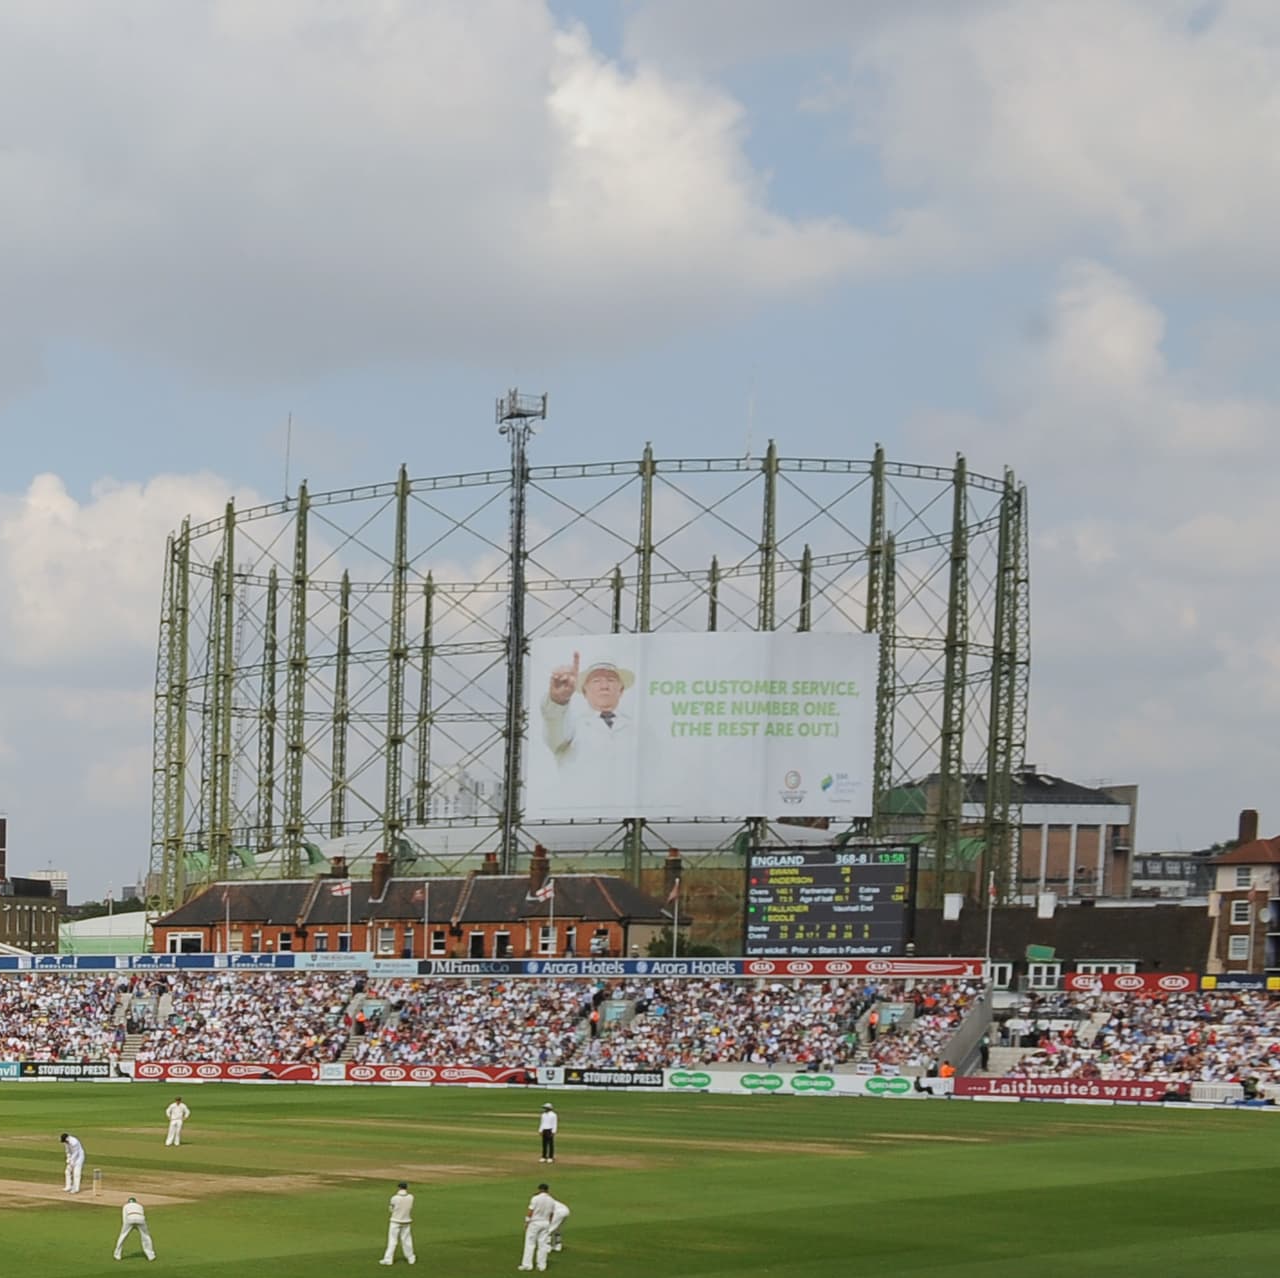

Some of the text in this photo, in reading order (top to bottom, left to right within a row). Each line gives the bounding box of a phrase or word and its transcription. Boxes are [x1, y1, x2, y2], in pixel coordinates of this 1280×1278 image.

[649, 680, 860, 698] FOR CUSTOMER SERVICE,
[671, 701, 841, 716] WE'RE NUMBER ONE.
[671, 721, 840, 738] (THE REST ARE OUT.)
[751, 855, 804, 866] ENGLAND
[542, 960, 624, 974] Arora Hotels
[652, 960, 736, 974] Arora Hotels
[38, 1065, 109, 1076] STOWFORD PRESS
[583, 1072, 662, 1085] STOWFORD PRESS
[990, 1079, 1154, 1098] Laithwaite's WINE
